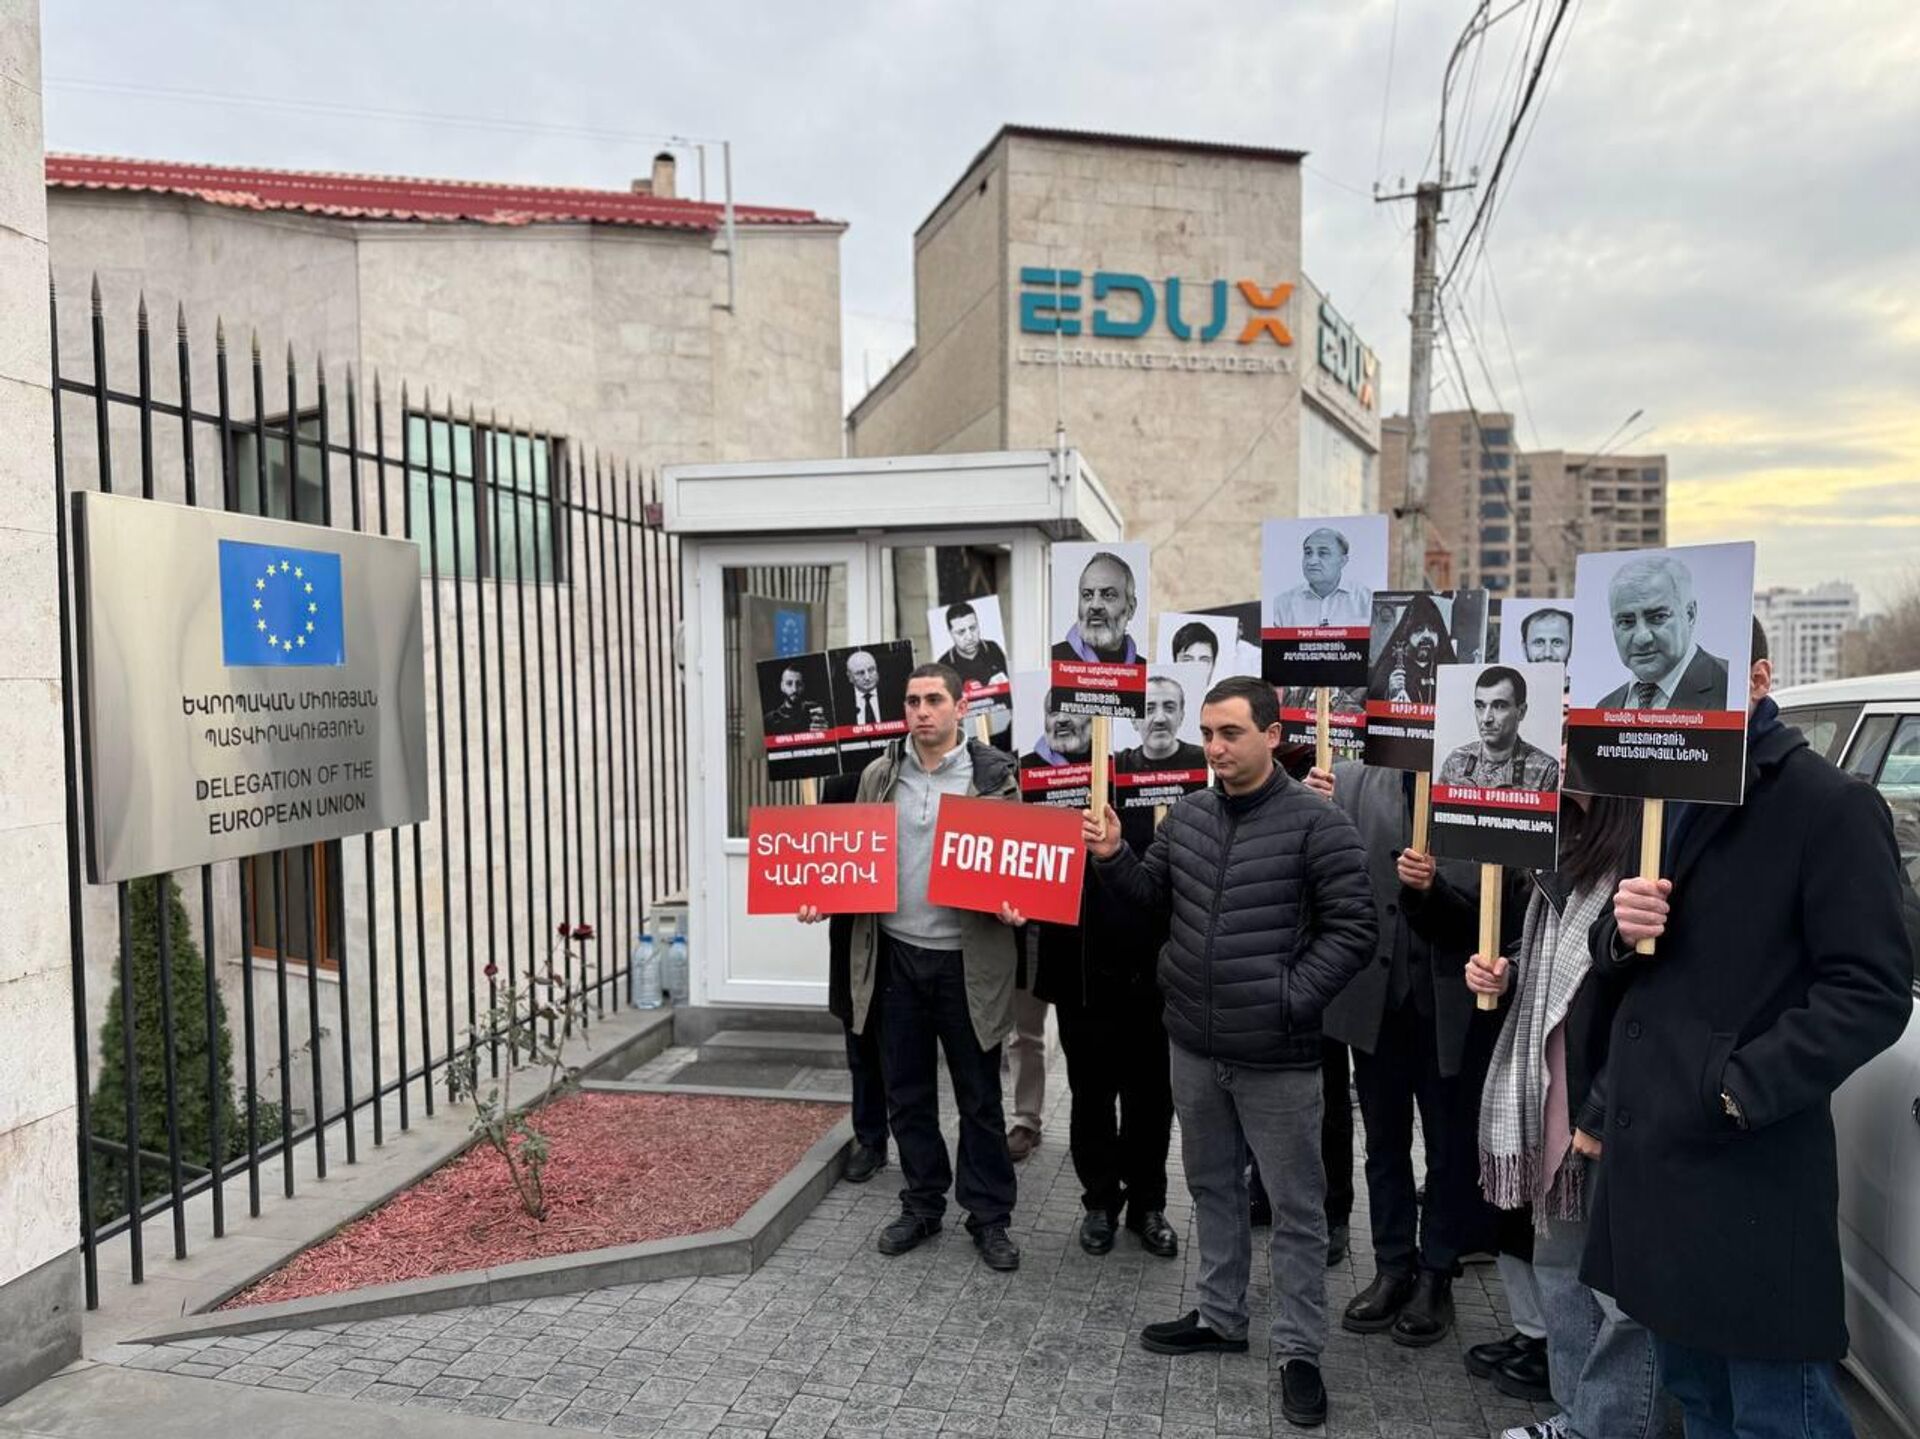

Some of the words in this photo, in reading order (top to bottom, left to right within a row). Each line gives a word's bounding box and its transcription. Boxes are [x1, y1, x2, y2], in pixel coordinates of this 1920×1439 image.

[1020, 267, 1294, 346] EDUX
[183, 693, 294, 715] ԵՎՐՈՊԱԿԱՆ
[300, 690, 378, 710] ՄԻՈՒԹՅԱՆ
[205, 720, 364, 747] ՊԱՏՎԻՐԱԿՈՒԹՅՈՒՆ
[1597, 746, 1708, 761] ՔԱՂԲԱՆՏԱՐԿՅԱԼՆԵՐԻՆ
[196, 768, 311, 800] DELEGATION
[318, 765, 339, 784] OF
[344, 761, 374, 780] THE
[209, 799, 312, 834] EUROPEAN
[317, 793, 366, 817] UNION
[757, 831, 864, 856] ՏՐՎՈՒՄ
[871, 831, 888, 852] Է
[940, 831, 994, 873] FOR
[999, 838, 1075, 883] RENT
[764, 861, 878, 886] ՎԱՐՁՈՎ
